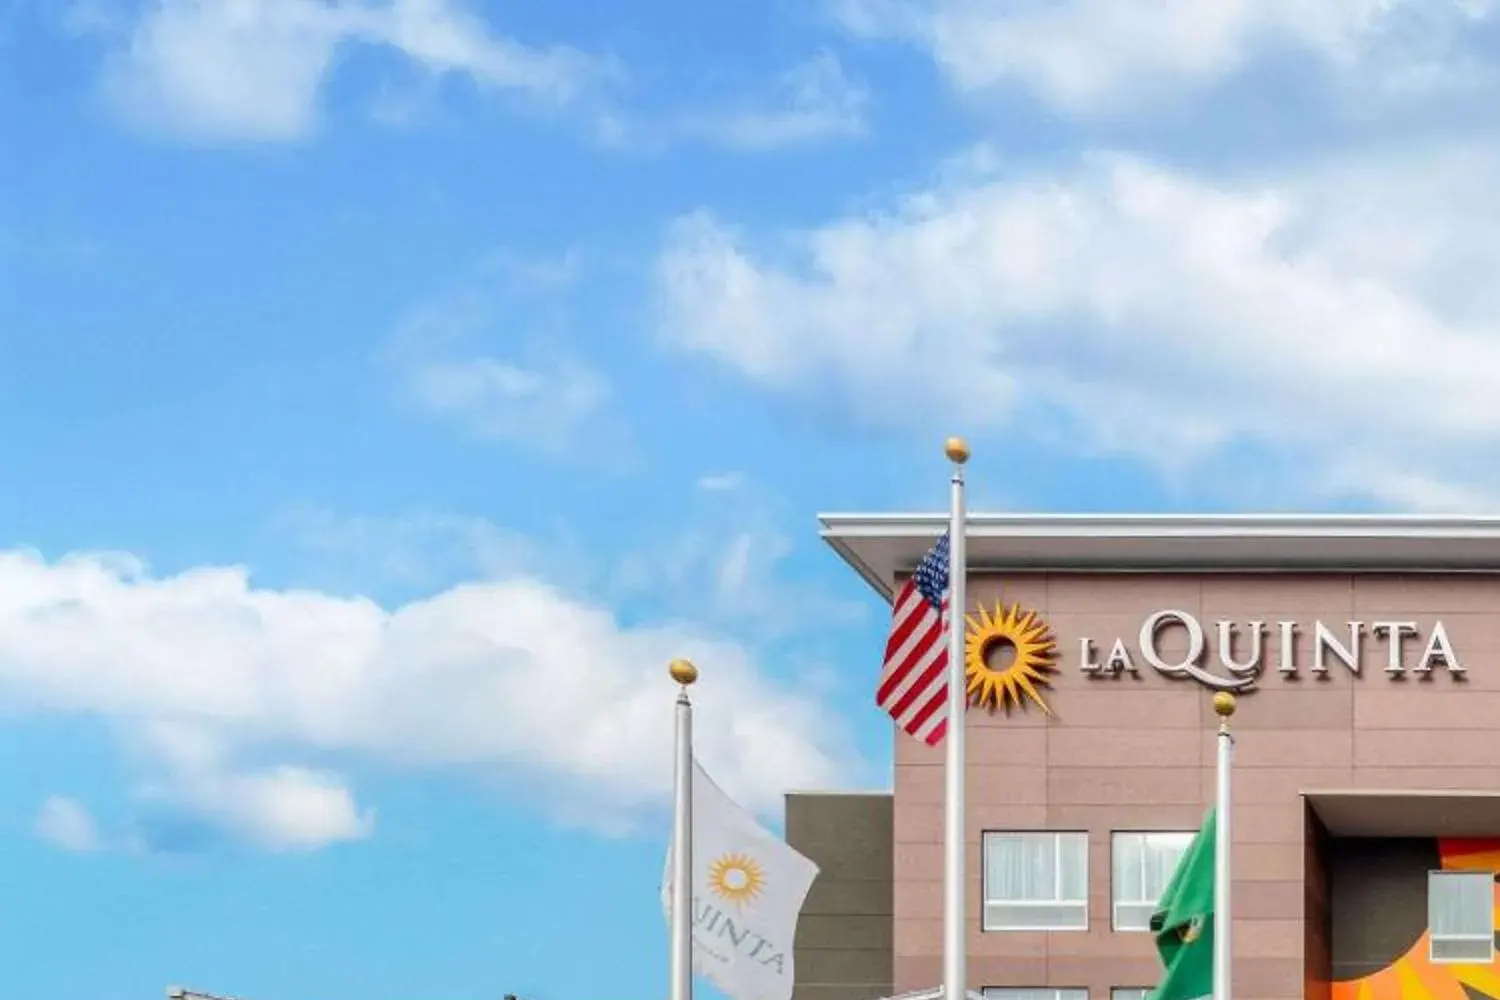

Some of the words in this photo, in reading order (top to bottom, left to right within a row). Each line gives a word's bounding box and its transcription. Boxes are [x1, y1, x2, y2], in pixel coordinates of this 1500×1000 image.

[1079, 636, 1138, 673] LA
[1139, 609, 1468, 690] QUINTA
[693, 896, 785, 975] UINTA
